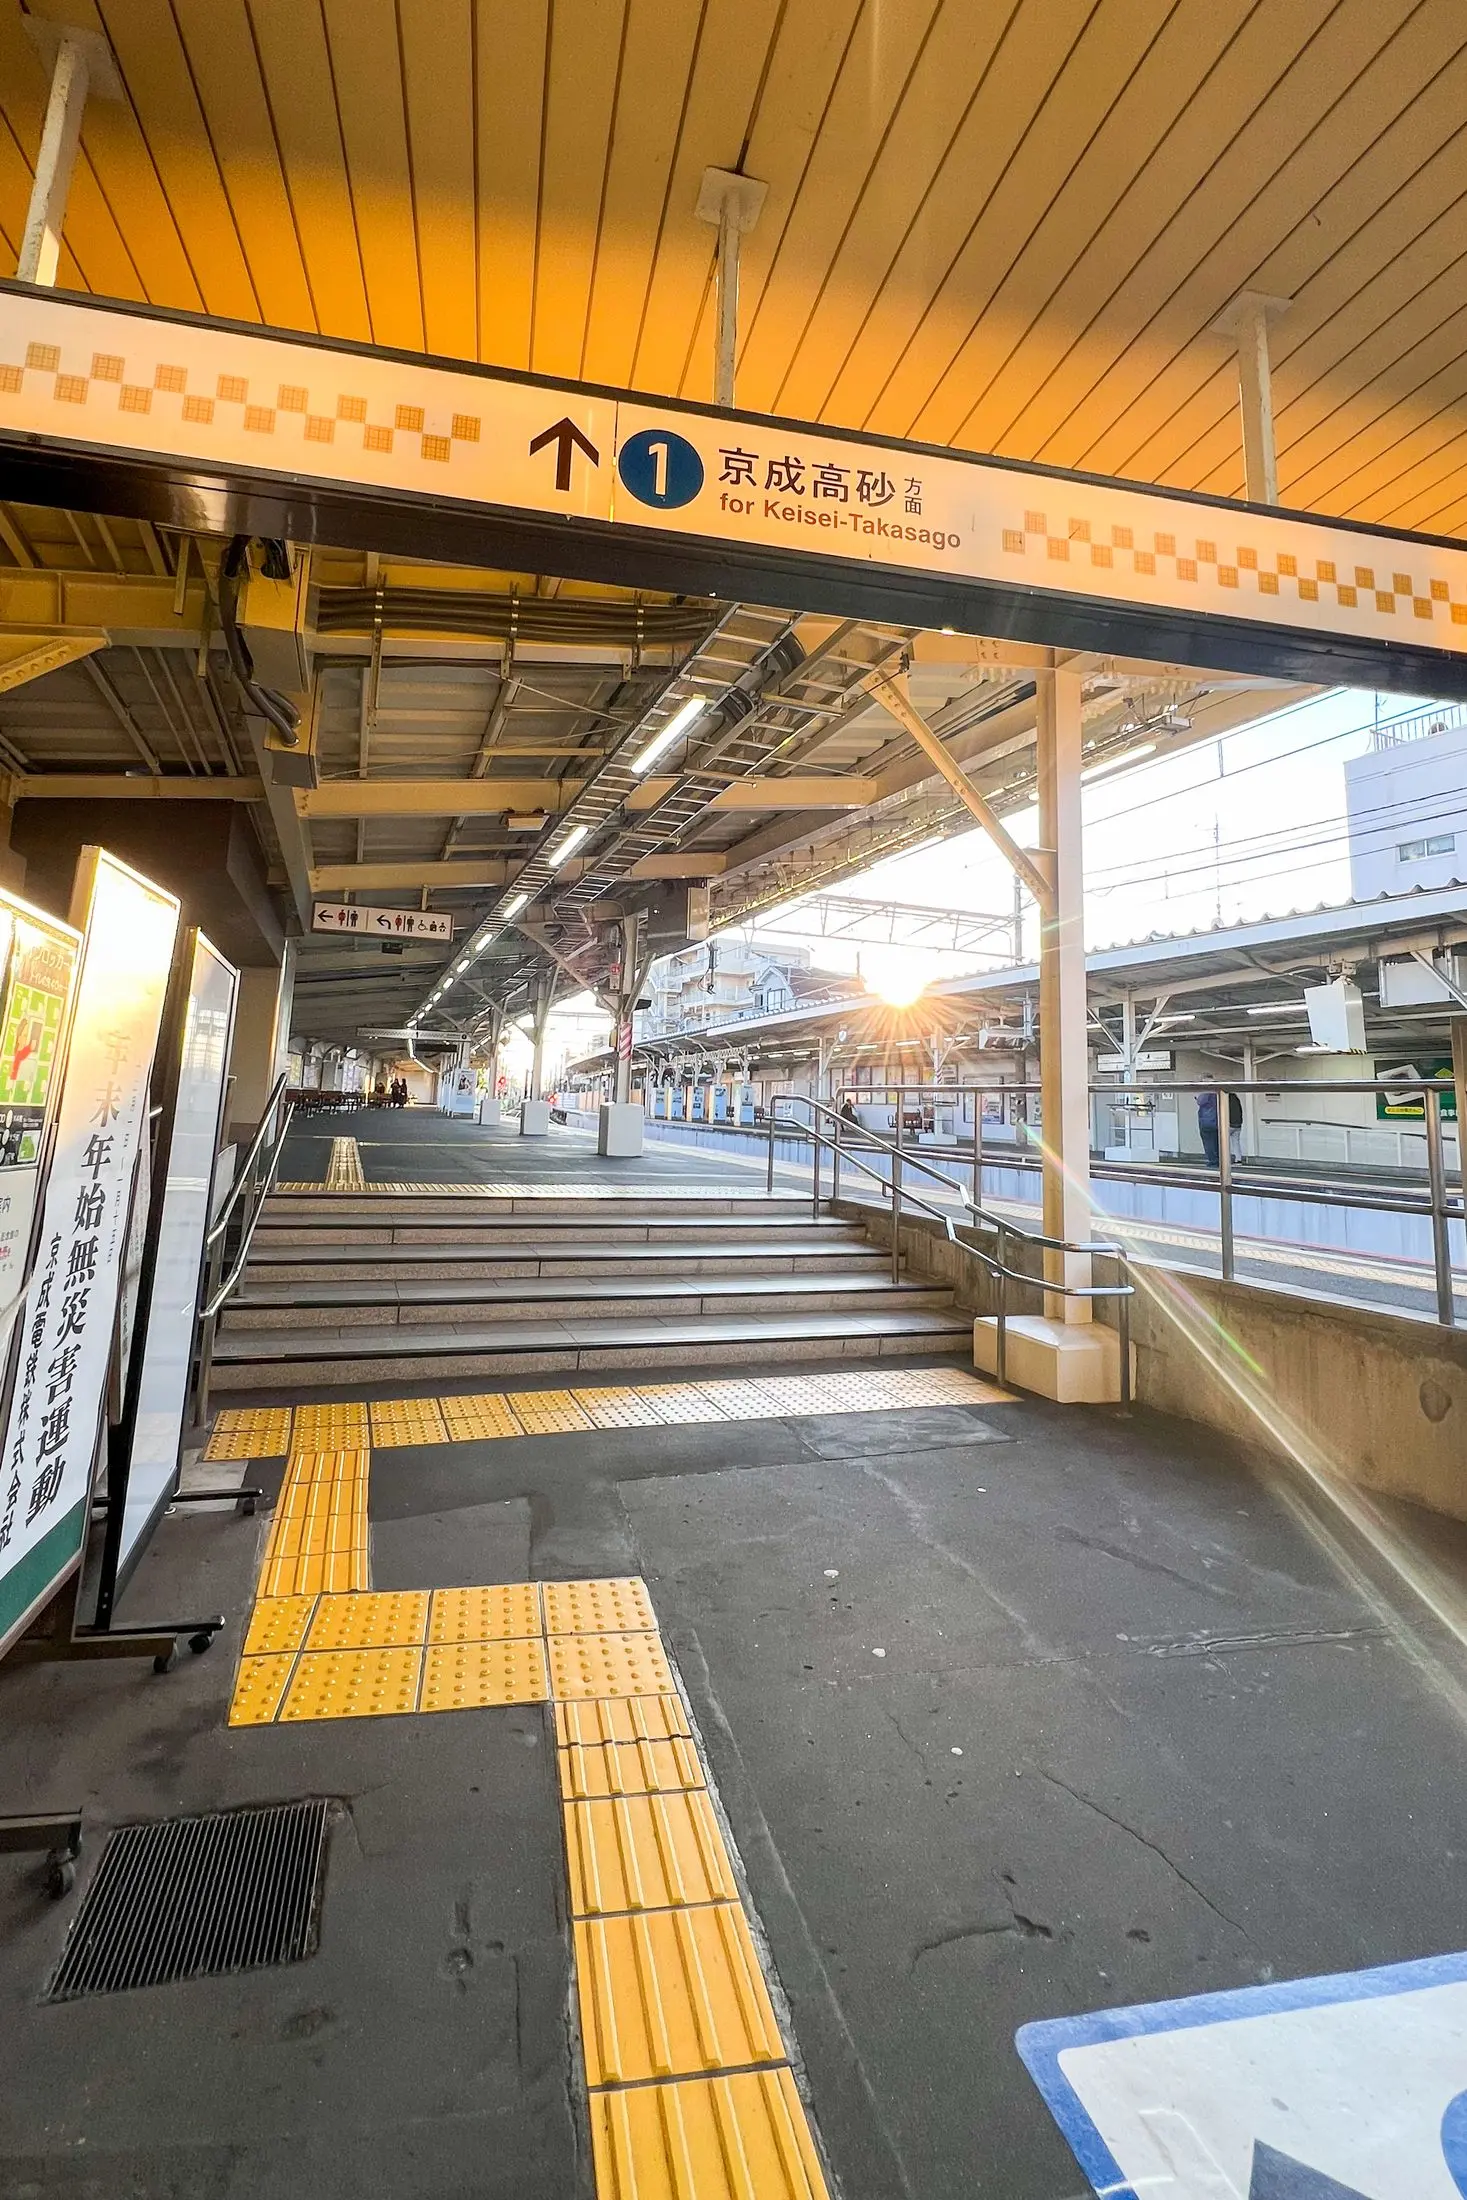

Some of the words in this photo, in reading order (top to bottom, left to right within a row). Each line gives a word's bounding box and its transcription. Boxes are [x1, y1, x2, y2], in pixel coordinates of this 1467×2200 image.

[647, 442, 670, 497] 1
[717, 446, 897, 507] 京成高砂
[903, 476, 923, 517] 方面
[719, 492, 755, 514] for
[763, 499, 963, 551] Keisei-Takasago
